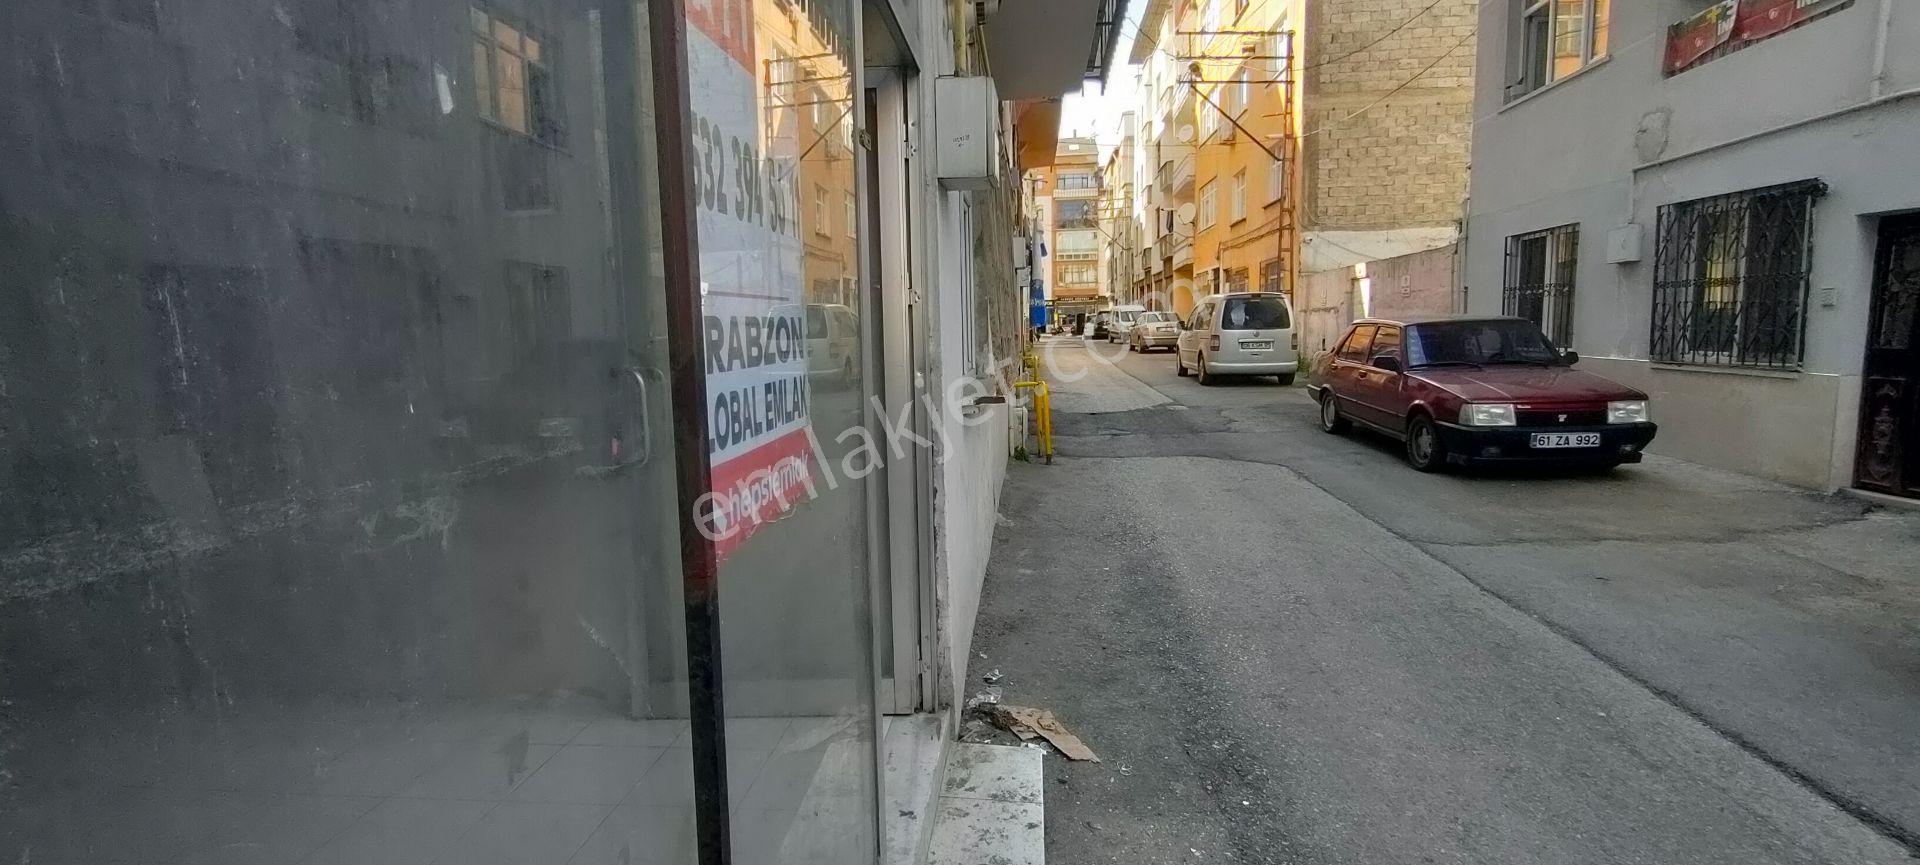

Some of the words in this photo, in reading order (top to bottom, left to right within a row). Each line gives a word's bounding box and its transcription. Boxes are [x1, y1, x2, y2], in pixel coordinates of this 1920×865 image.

[704, 315, 804, 374] RABZON
[764, 374, 808, 432] EMLAK
[1537, 435, 1551, 447] 61
[1555, 435, 1570, 446] ZA
[1575, 435, 1599, 446] 992
